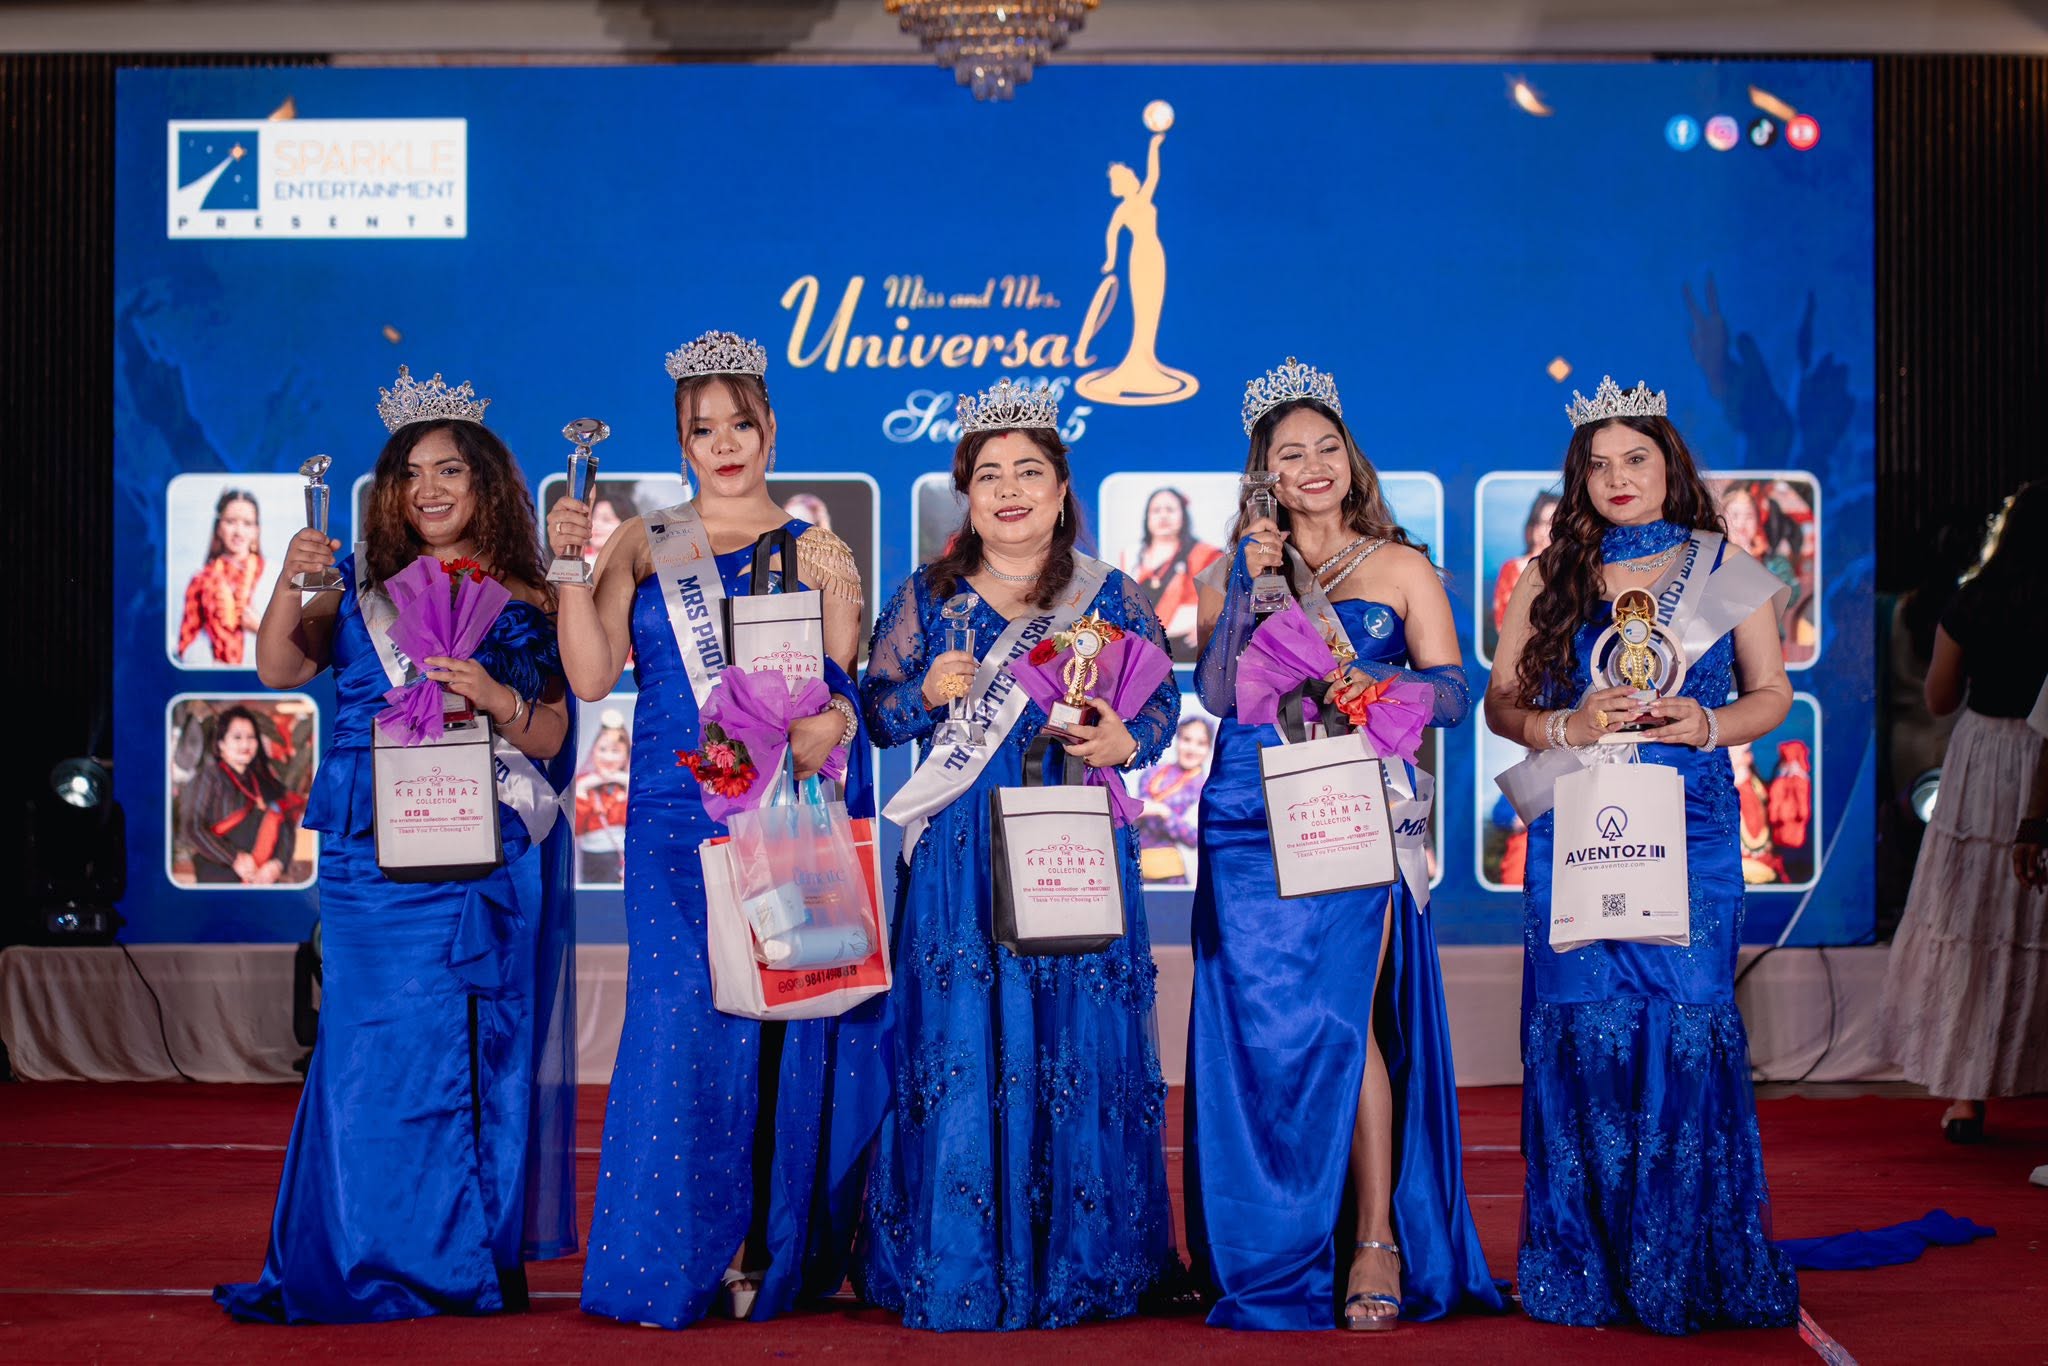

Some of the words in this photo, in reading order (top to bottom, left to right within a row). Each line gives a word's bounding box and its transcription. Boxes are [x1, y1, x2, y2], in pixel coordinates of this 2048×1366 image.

[275, 139, 456, 177] SPARKLE
[274, 181, 456, 200] ENTERTAINMENT
[178, 215, 454, 229] PRESENTS
[883, 275, 945, 310] Miss
[949, 278, 996, 308] and
[1000, 275, 1061, 310] Mrs.
[780, 273, 1118, 373] Universal
[1059, 406, 1094, 443] 5
[677, 575, 709, 621] MRS
[1021, 615, 1056, 645] MRS
[395, 786, 478, 797] KRISHMAZ
[416, 797, 457, 805] COLLECTION
[1289, 802, 1372, 821] KRISHMAZ
[1311, 816, 1351, 827] COLLECTION
[1394, 816, 1427, 836] MR
[1027, 857, 1105, 866] KRISHMAZ
[1565, 844, 1647, 866] AVENTOZ
[1582, 862, 1646, 871] www.aventoz.com
